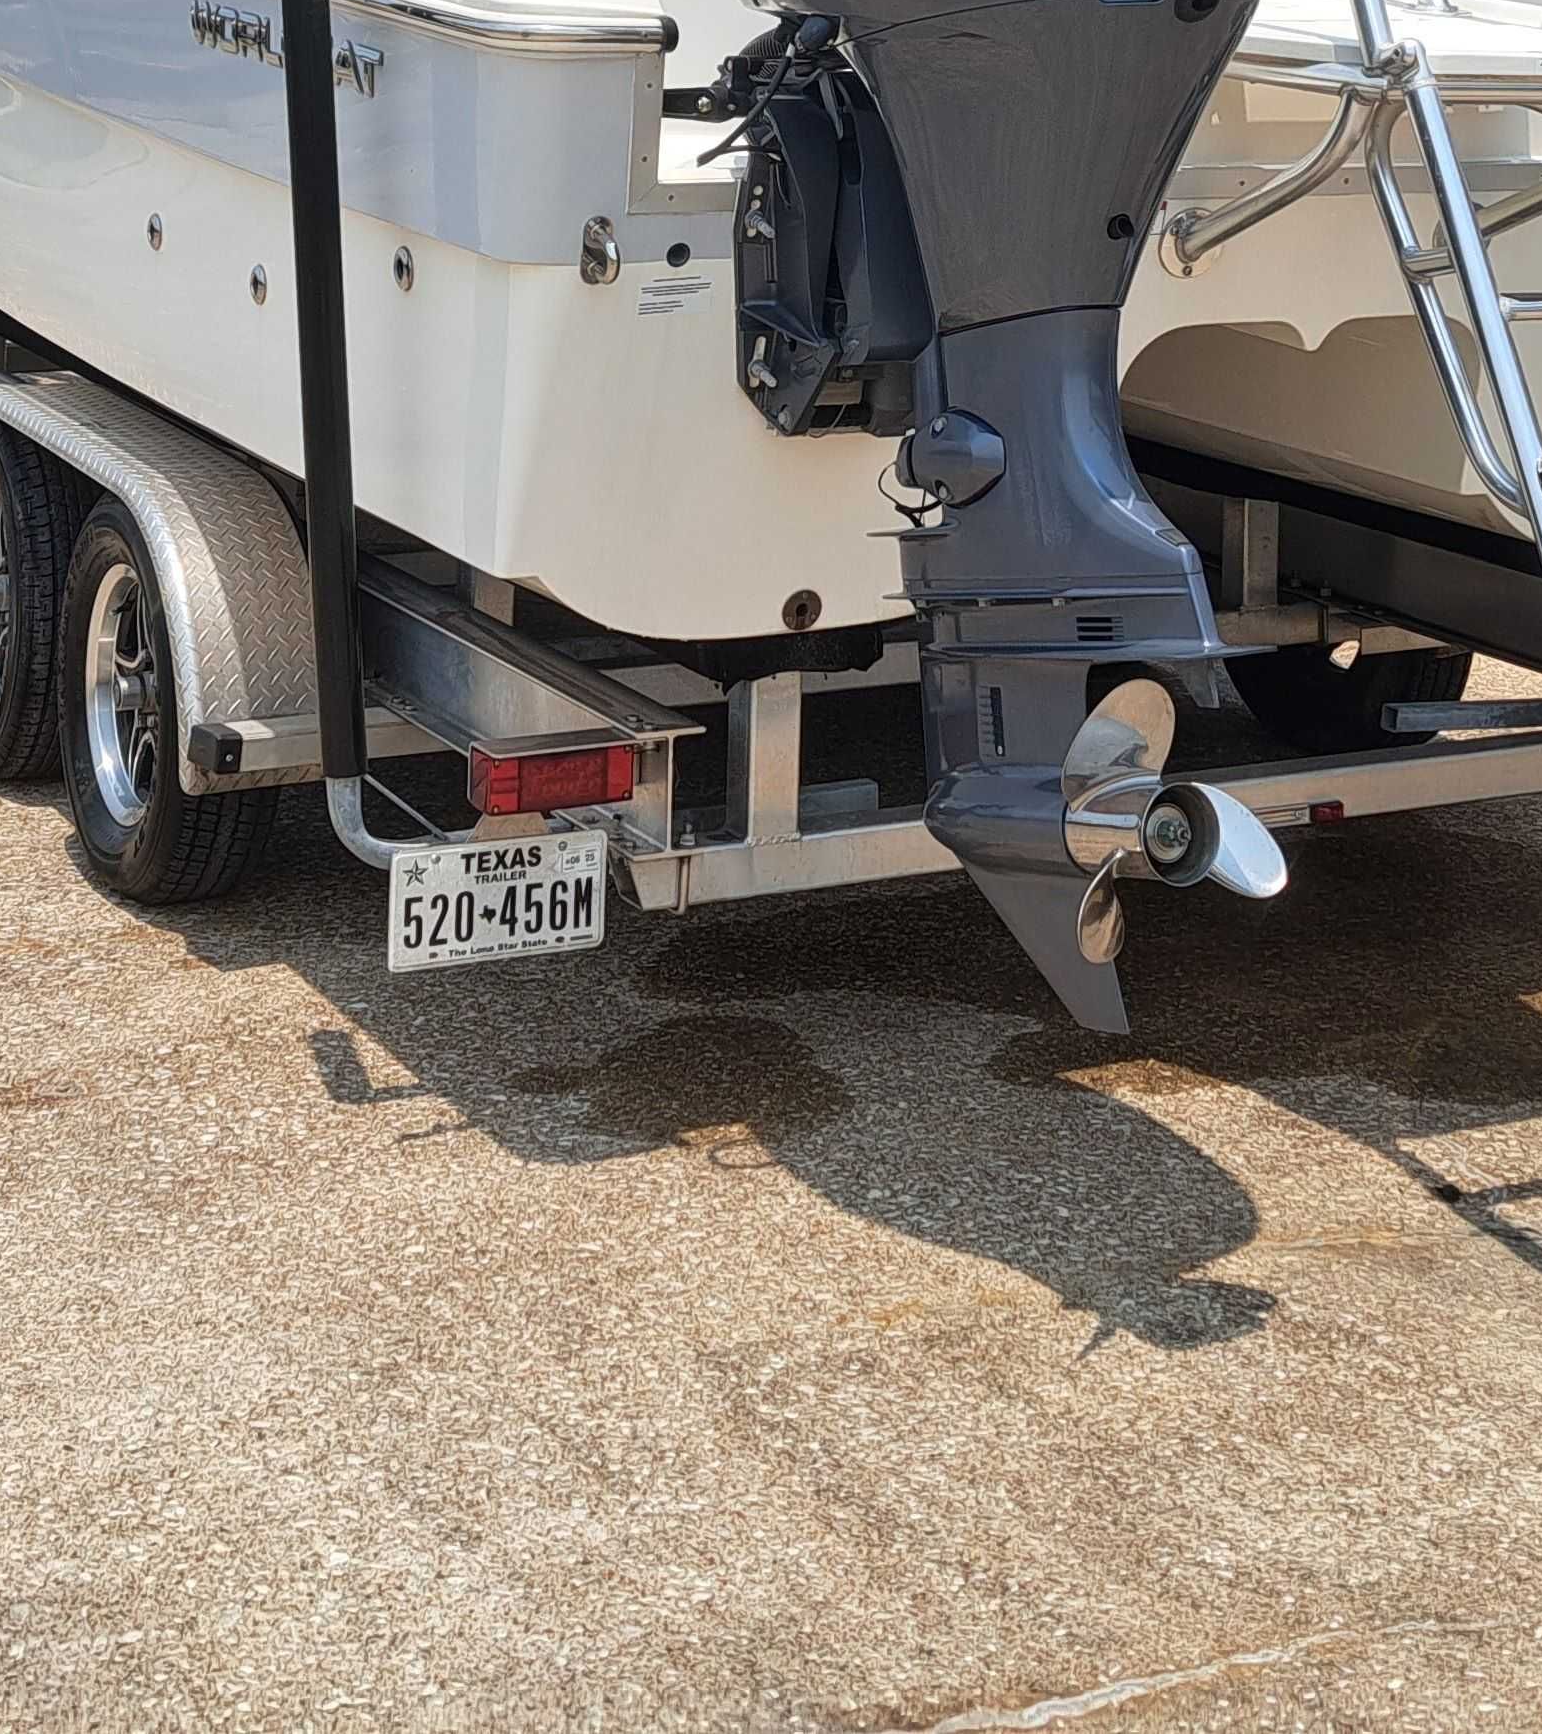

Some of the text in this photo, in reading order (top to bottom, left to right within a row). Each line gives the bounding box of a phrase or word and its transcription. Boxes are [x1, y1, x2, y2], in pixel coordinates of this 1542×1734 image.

[461, 845, 541, 875] TEXAS
[474, 870, 527, 884] TRAILER
[403, 876, 594, 949] 520 456M
[448, 937, 548, 958] The Lone Star State
